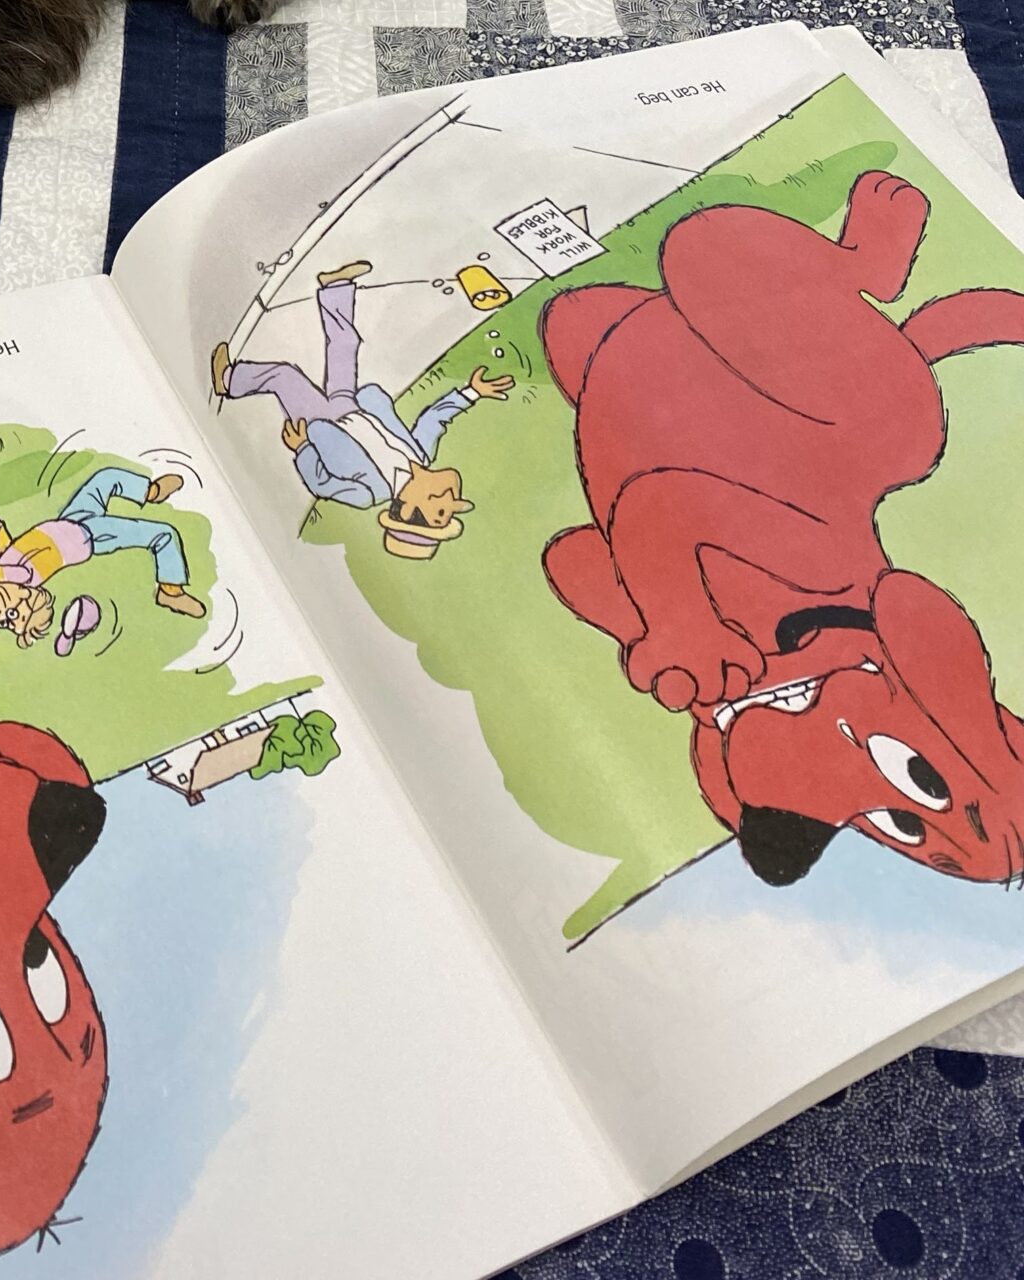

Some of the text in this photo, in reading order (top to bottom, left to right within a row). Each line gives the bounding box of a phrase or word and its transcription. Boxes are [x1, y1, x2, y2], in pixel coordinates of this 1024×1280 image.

[635, 80, 725, 106] He can beg.
[507, 207, 559, 240] KIBBLES
[533, 223, 562, 240] FOR
[536, 232, 577, 255] WORK
[558, 240, 592, 259] WILL
